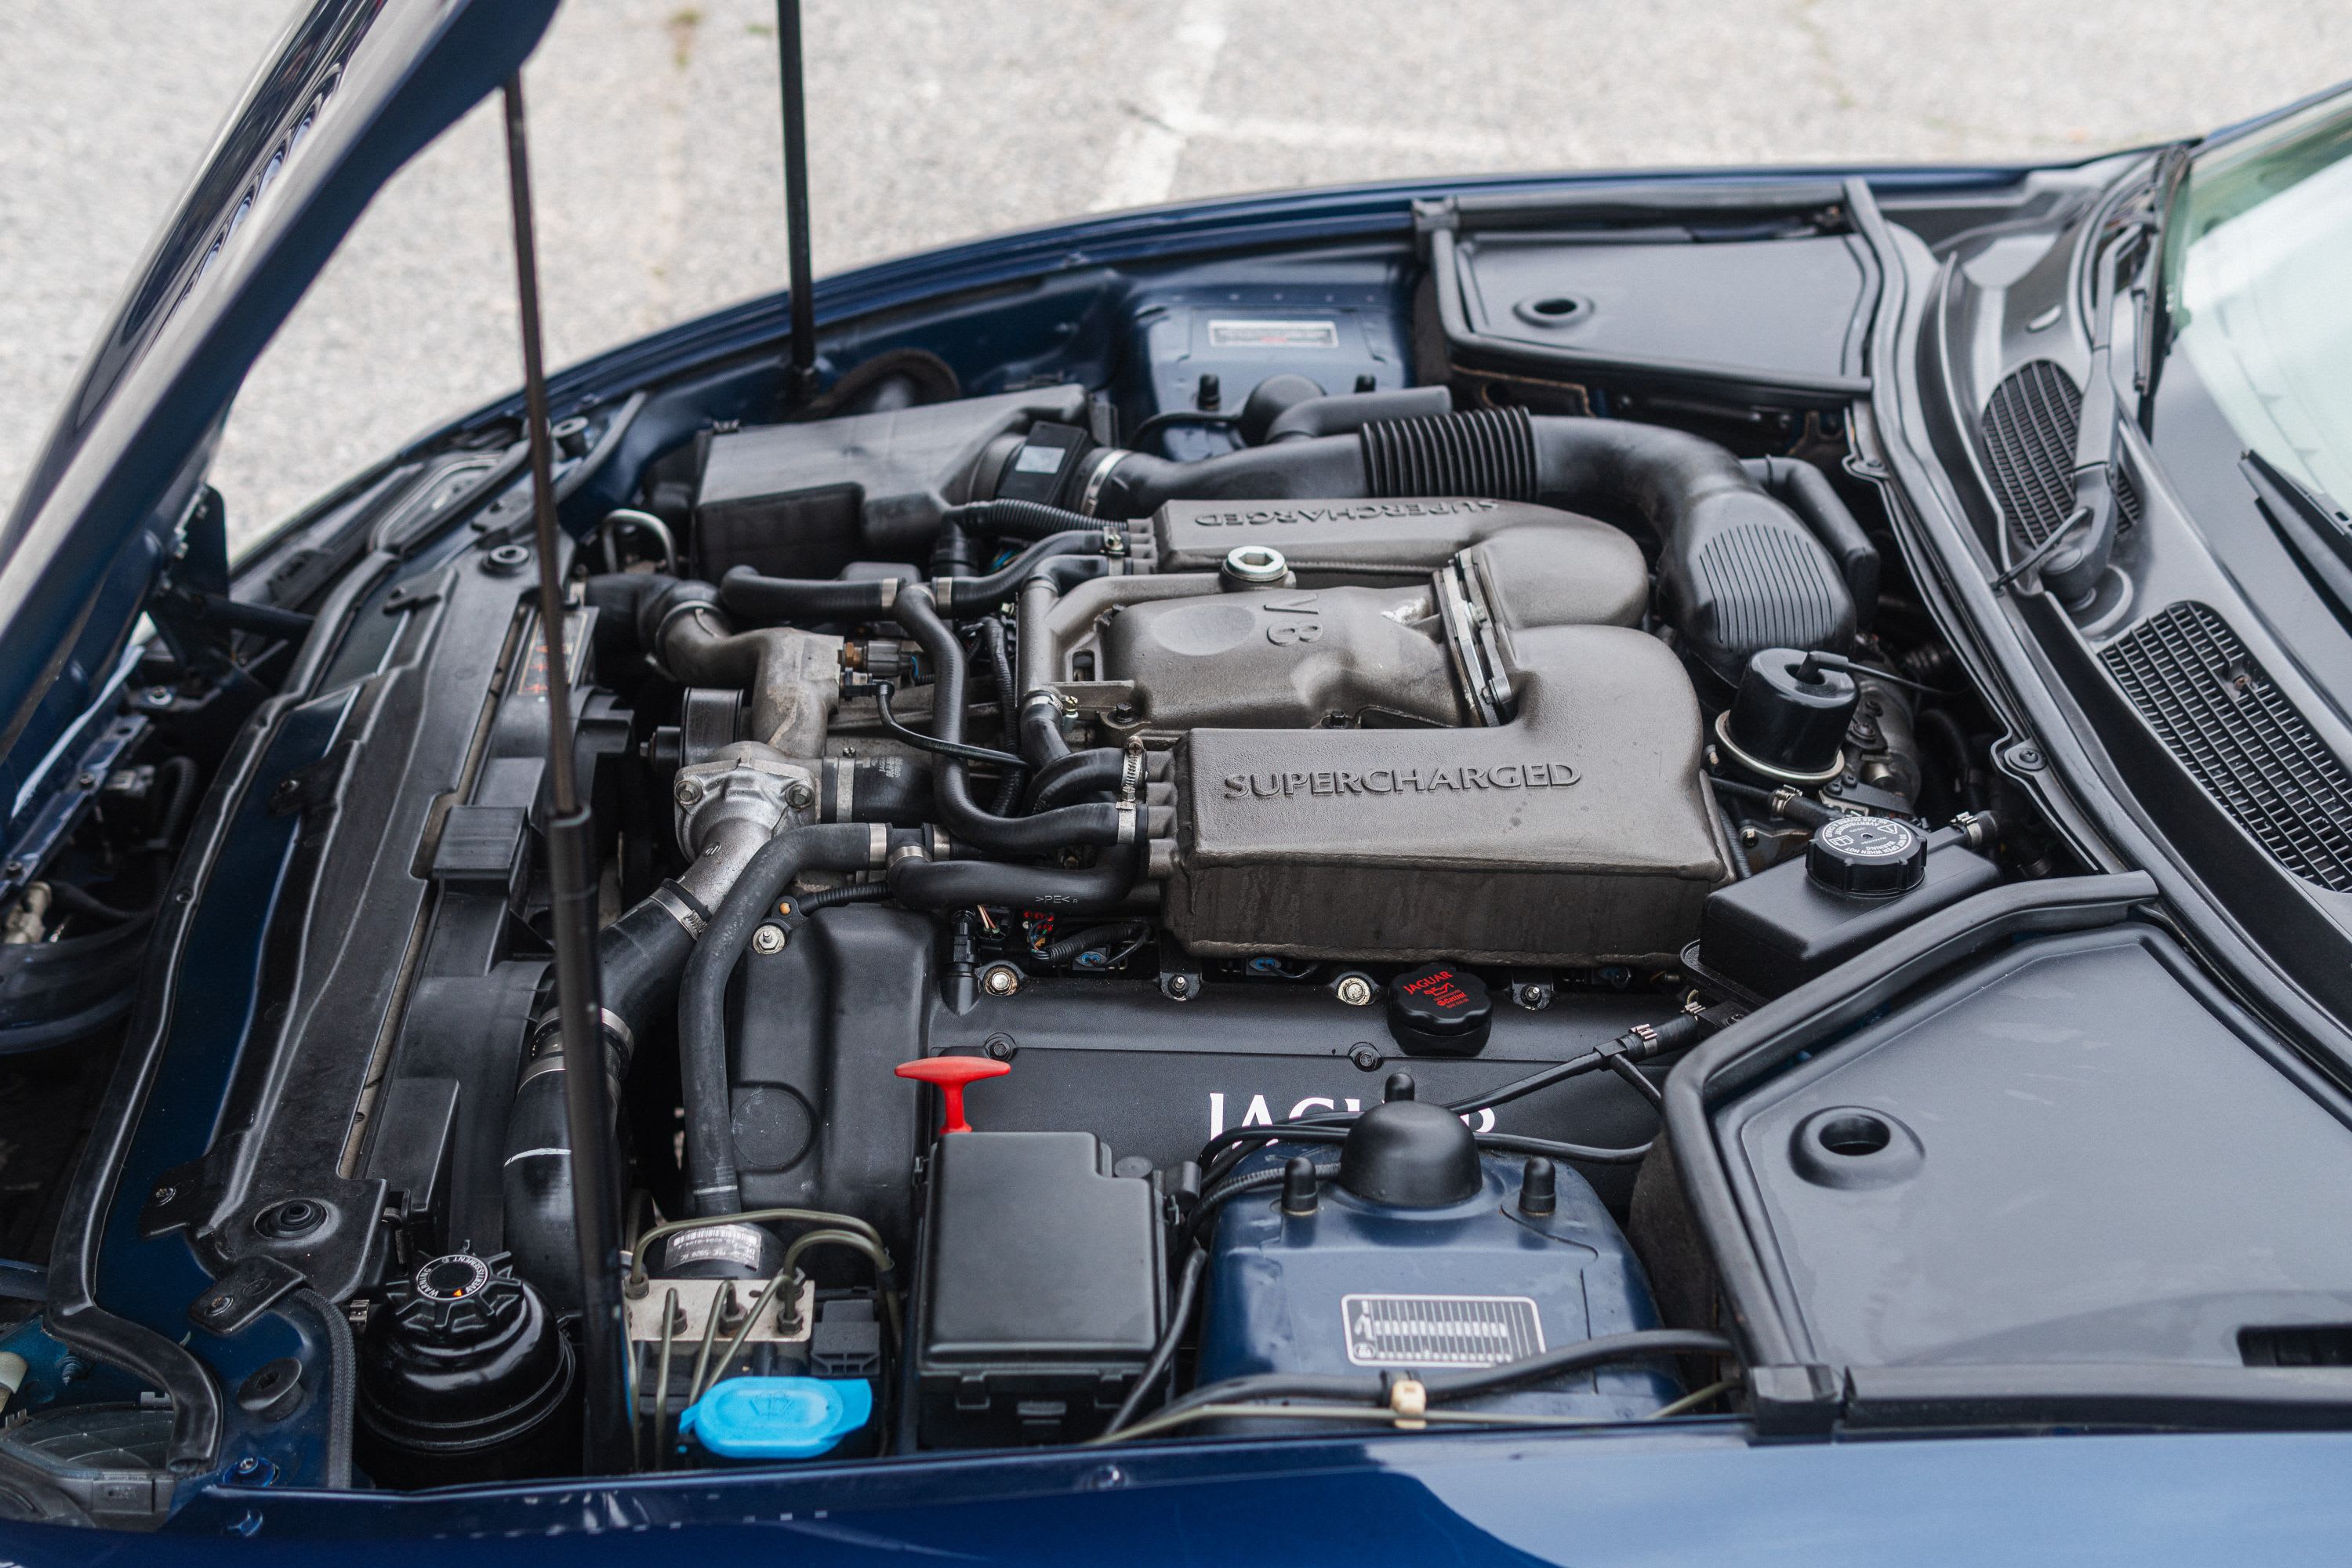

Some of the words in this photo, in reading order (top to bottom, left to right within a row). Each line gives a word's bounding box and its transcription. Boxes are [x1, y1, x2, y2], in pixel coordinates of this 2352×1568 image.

[1195, 499, 1500, 527] SUPERCHARGED
[1263, 593, 1323, 647] V8
[1224, 762, 1581, 798] SUPERCHARGED
[1866, 841, 1896, 850] WARNING
[1403, 971, 1454, 995] JAGUAR
[1444, 992, 1467, 1004] Castrol
[419, 1268, 439, 1298] WARNING
